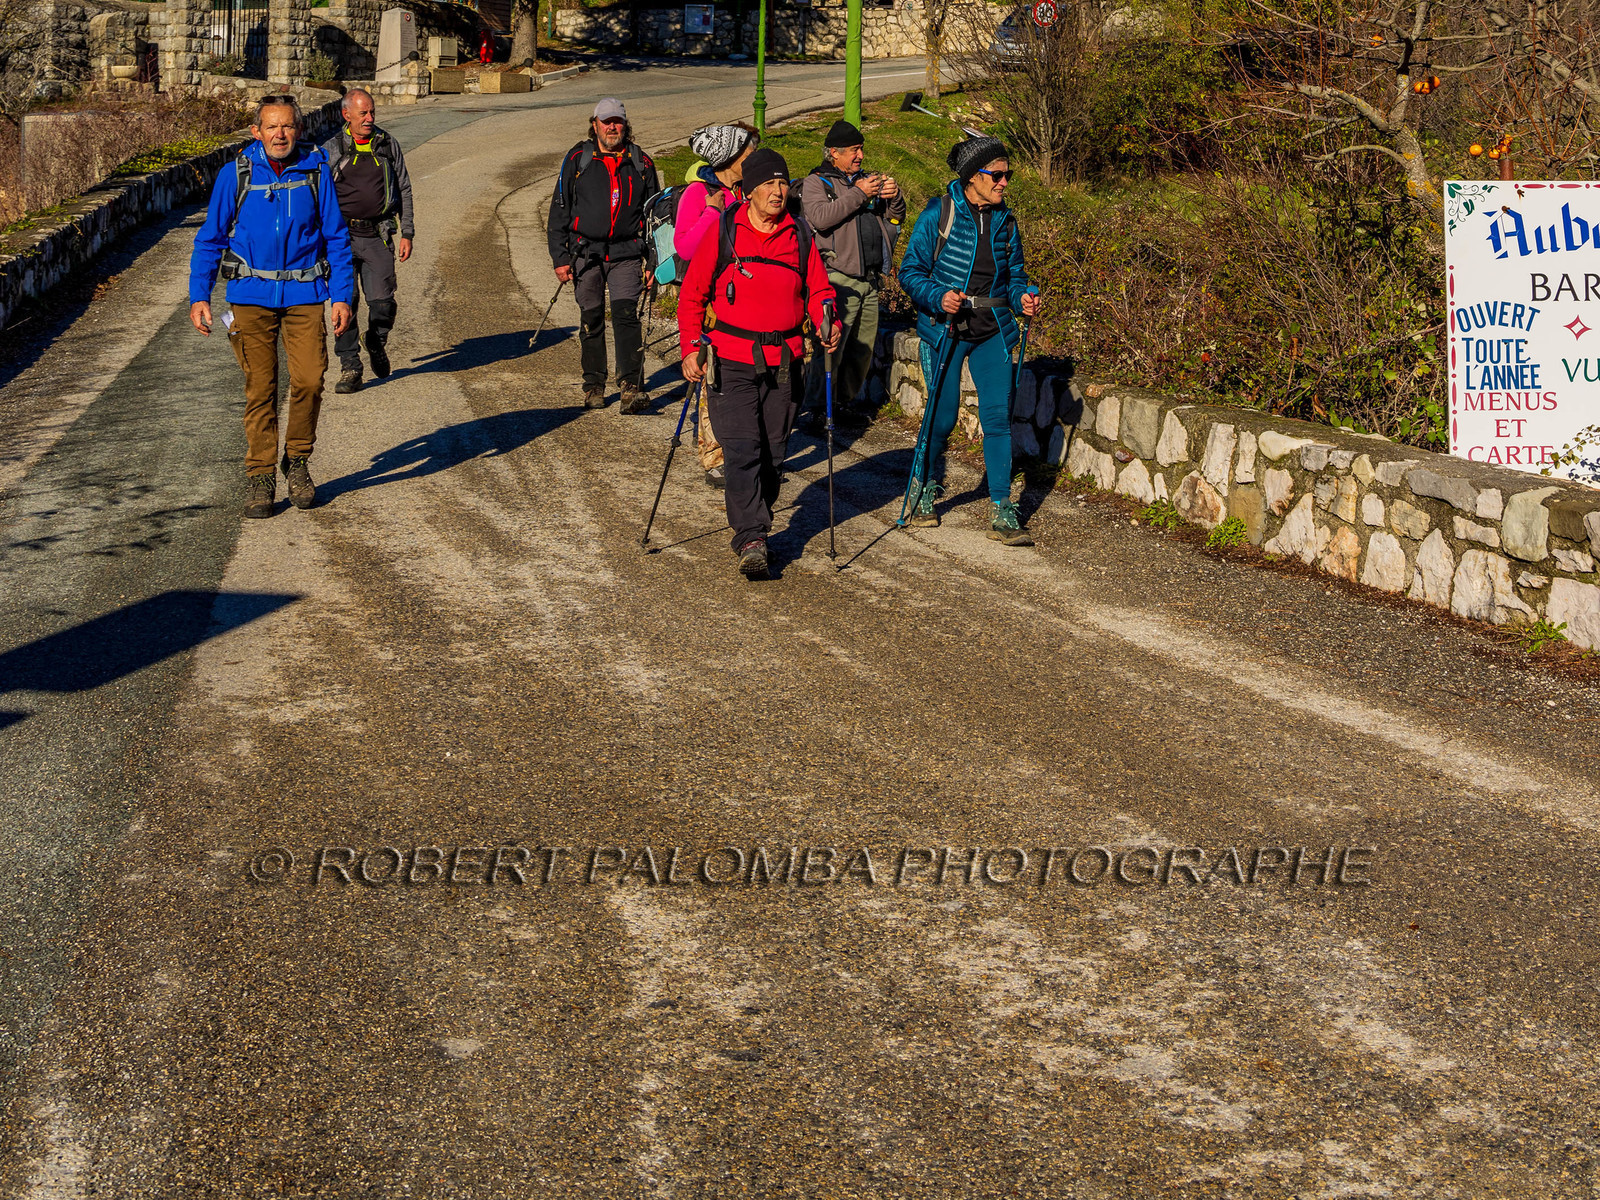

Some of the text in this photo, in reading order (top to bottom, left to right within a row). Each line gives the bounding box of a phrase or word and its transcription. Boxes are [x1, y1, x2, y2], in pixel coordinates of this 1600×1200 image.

[1530, 273, 1600, 302] BAR
[1456, 301, 1540, 333] OUVERT
[1462, 337, 1526, 364] TOUTE
[1463, 391, 1558, 411] MENUS
[1495, 419, 1527, 437] ET
[1467, 445, 1556, 464] CARTE
